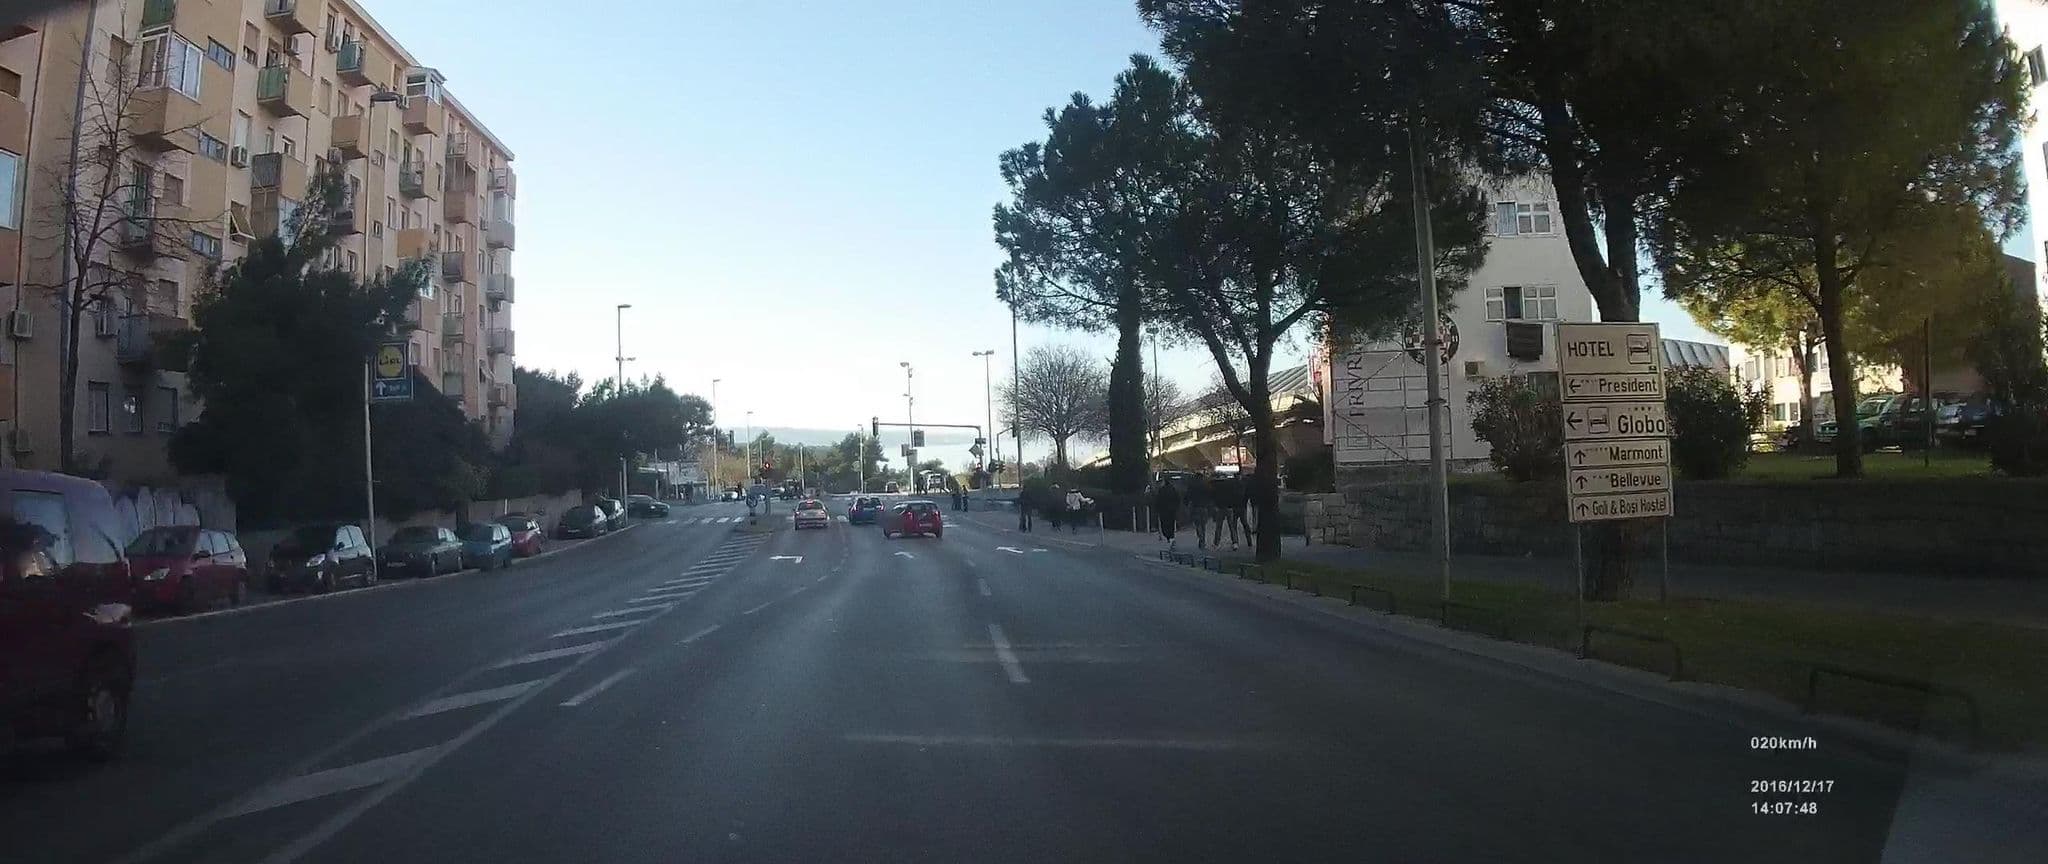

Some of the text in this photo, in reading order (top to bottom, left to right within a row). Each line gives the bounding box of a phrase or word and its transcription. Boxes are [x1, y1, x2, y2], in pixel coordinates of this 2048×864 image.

[1567, 341, 1615, 358] HOTEL
[1599, 378, 1659, 393] President
[1618, 414, 1665, 434] Globo
[1609, 444, 1664, 461] Marmont
[1611, 472, 1661, 488] Bellevue
[1610, 503, 1618, 514] &
[1619, 499, 1638, 514] Bosi
[1640, 497, 1666, 512] Hostel
